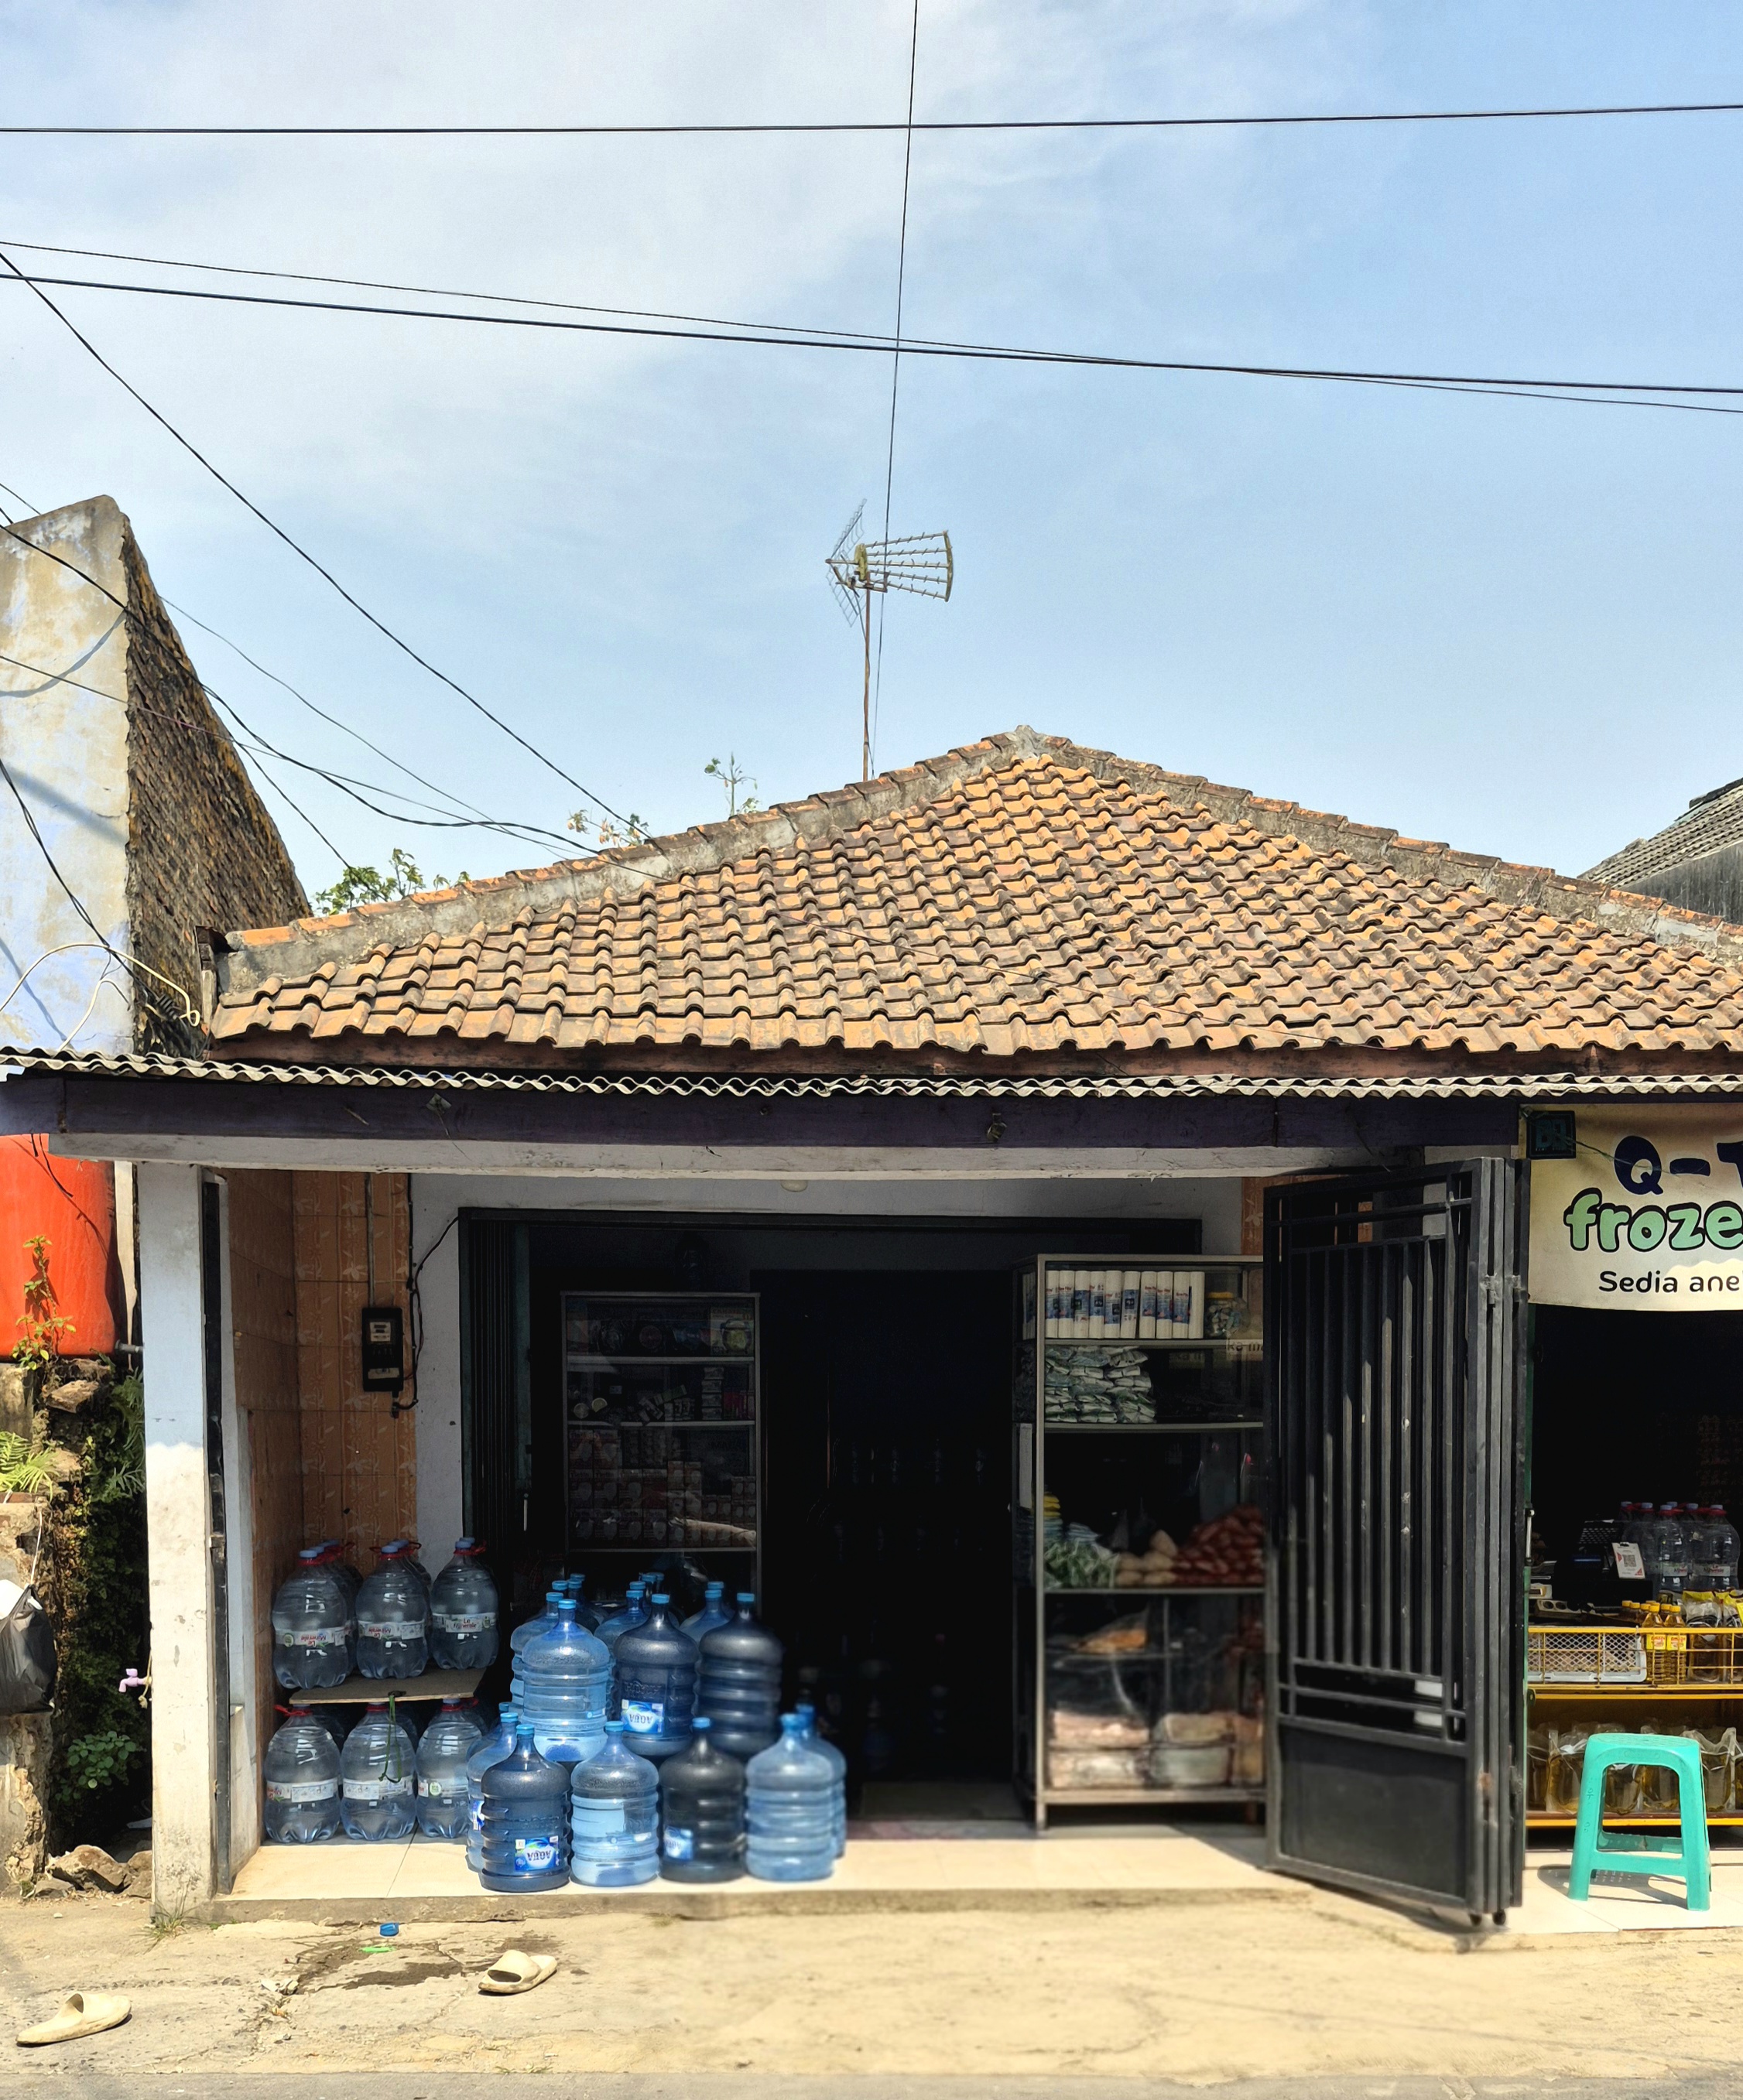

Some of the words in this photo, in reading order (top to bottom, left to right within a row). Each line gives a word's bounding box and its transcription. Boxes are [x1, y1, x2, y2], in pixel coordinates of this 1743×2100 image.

[1563, 1187, 1743, 1252] froze
[1598, 1270, 1677, 1293] Sedia
[1690, 1275, 1740, 1293] ane
[628, 1714, 653, 1724] AQUA
[526, 1850, 551, 1862] AQUA
